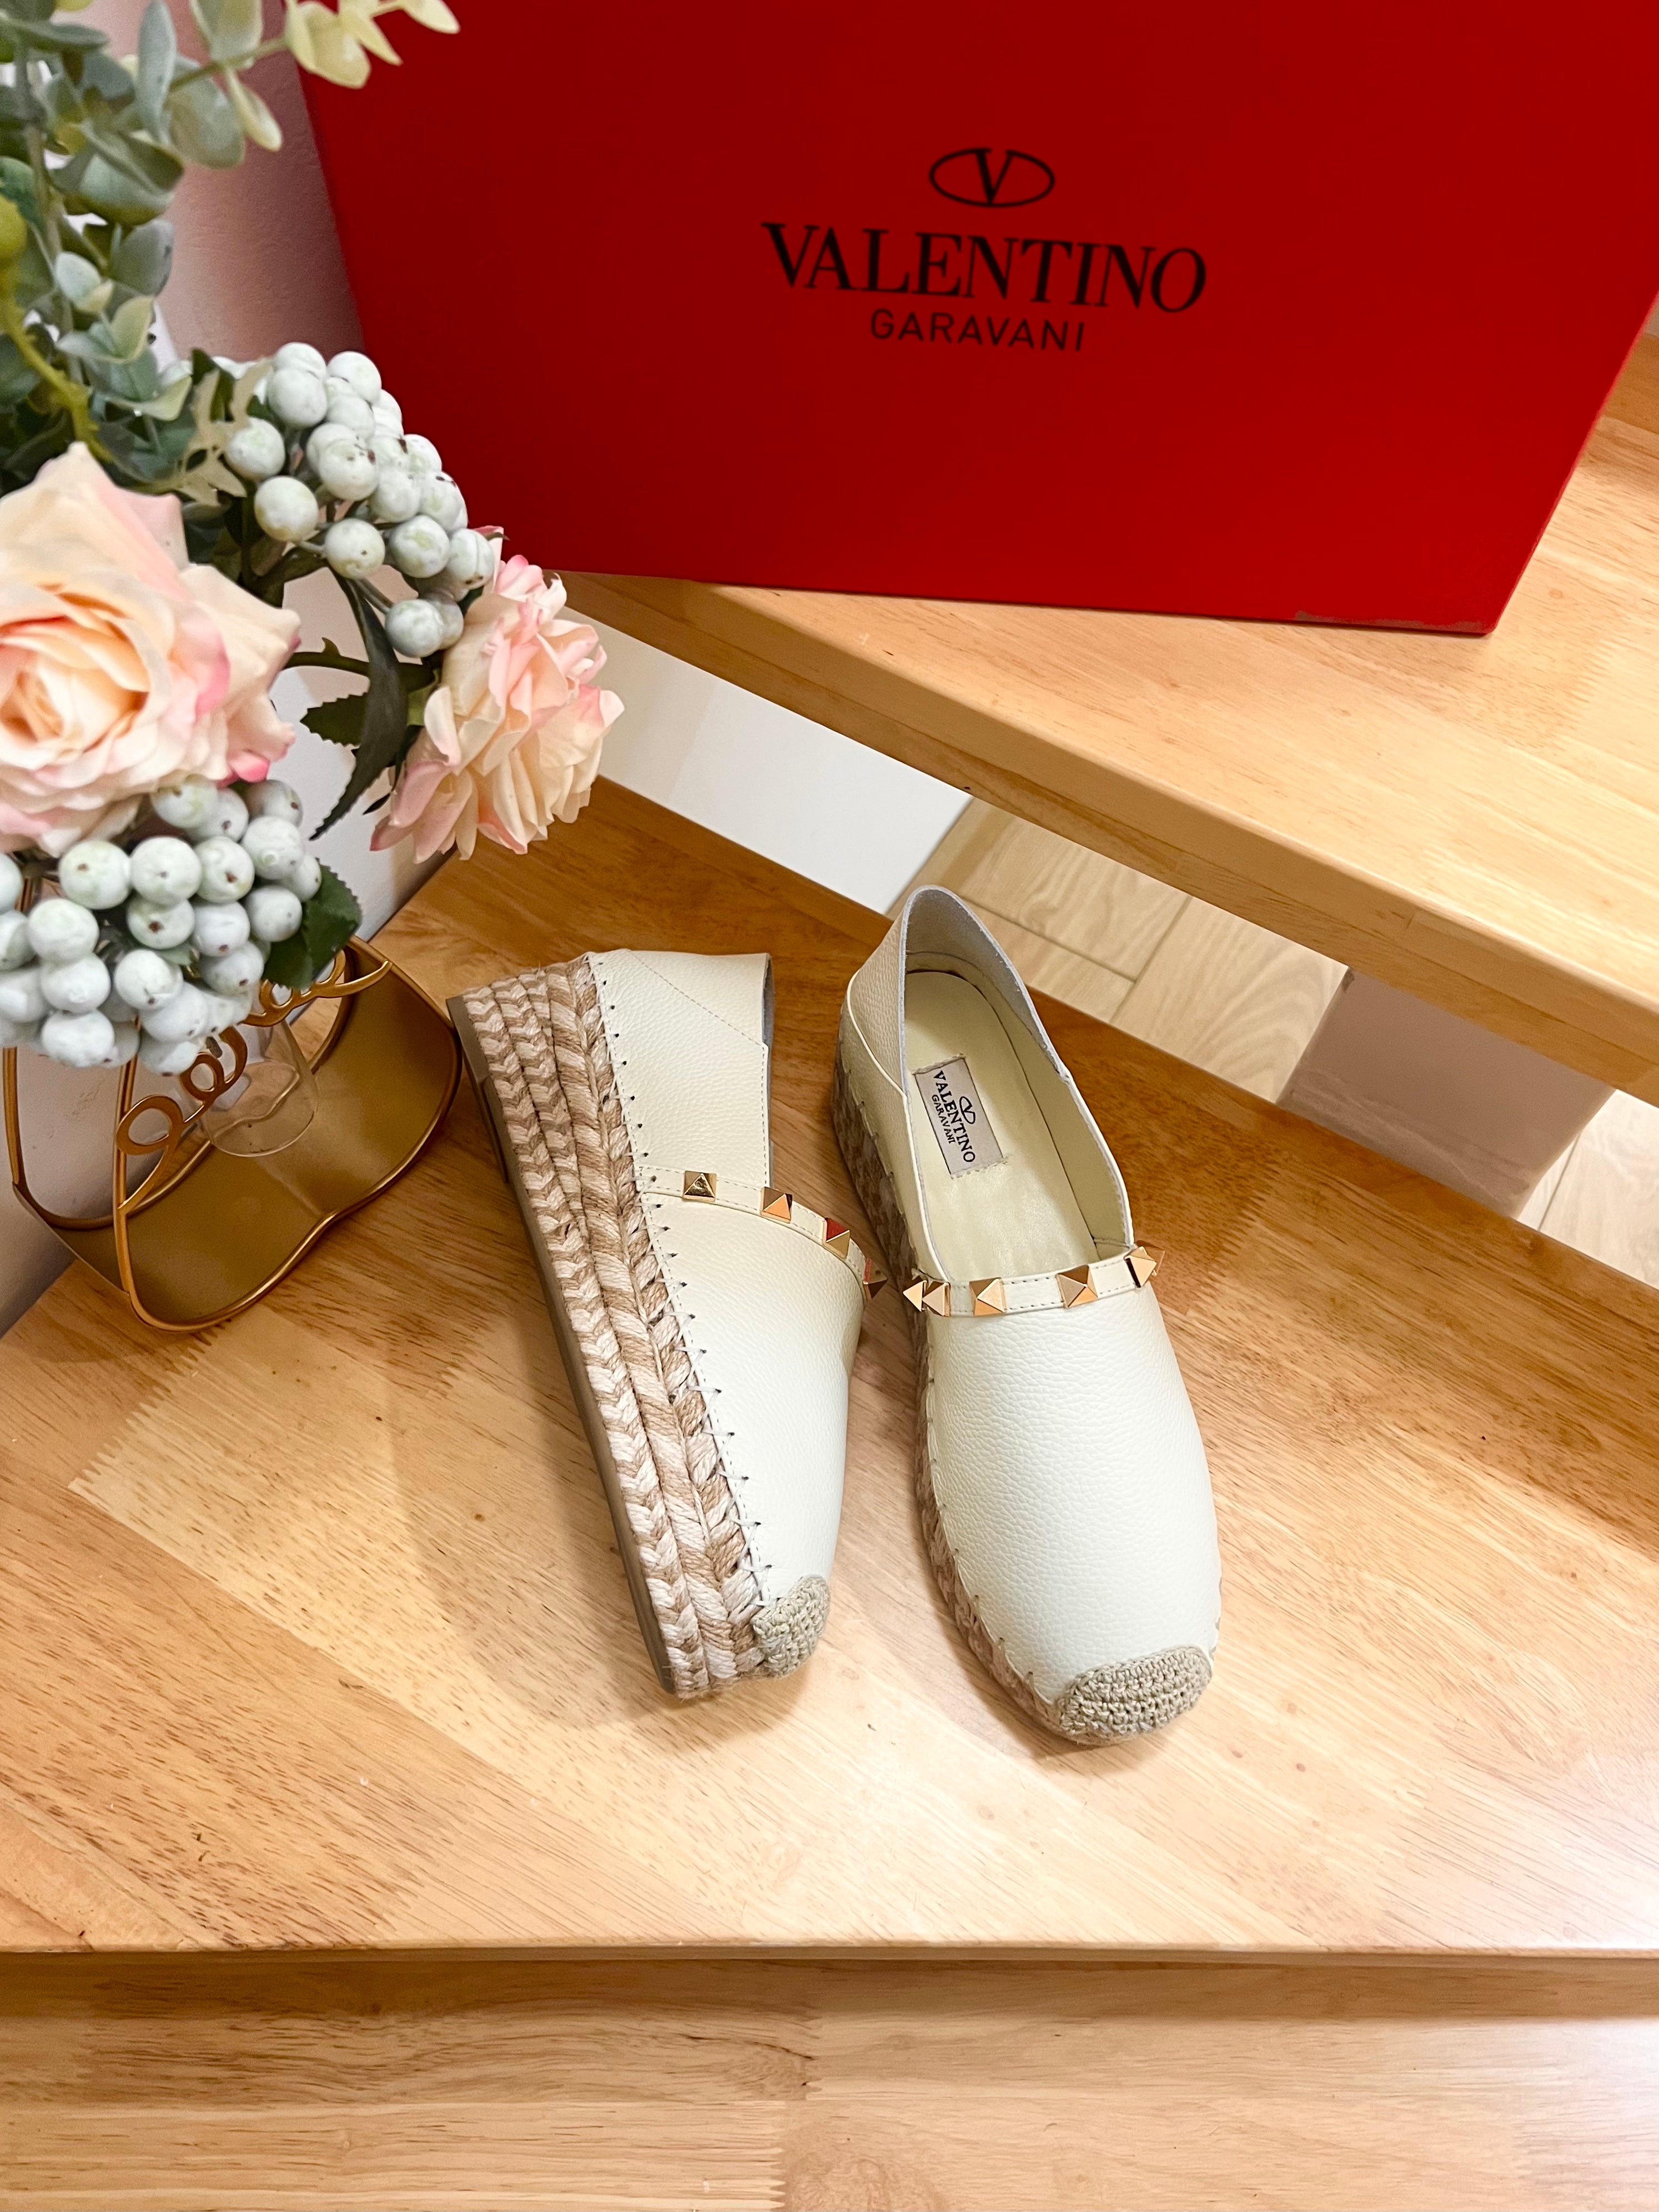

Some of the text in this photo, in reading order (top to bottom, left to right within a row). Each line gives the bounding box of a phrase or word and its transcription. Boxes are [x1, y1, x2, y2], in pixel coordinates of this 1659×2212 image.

[760, 221, 1207, 313] VALENTINO
[870, 308, 1085, 351] GARAVANI
[932, 1094, 956, 1144] GARAVANI
[933, 1070, 976, 1162] VALENTINO
